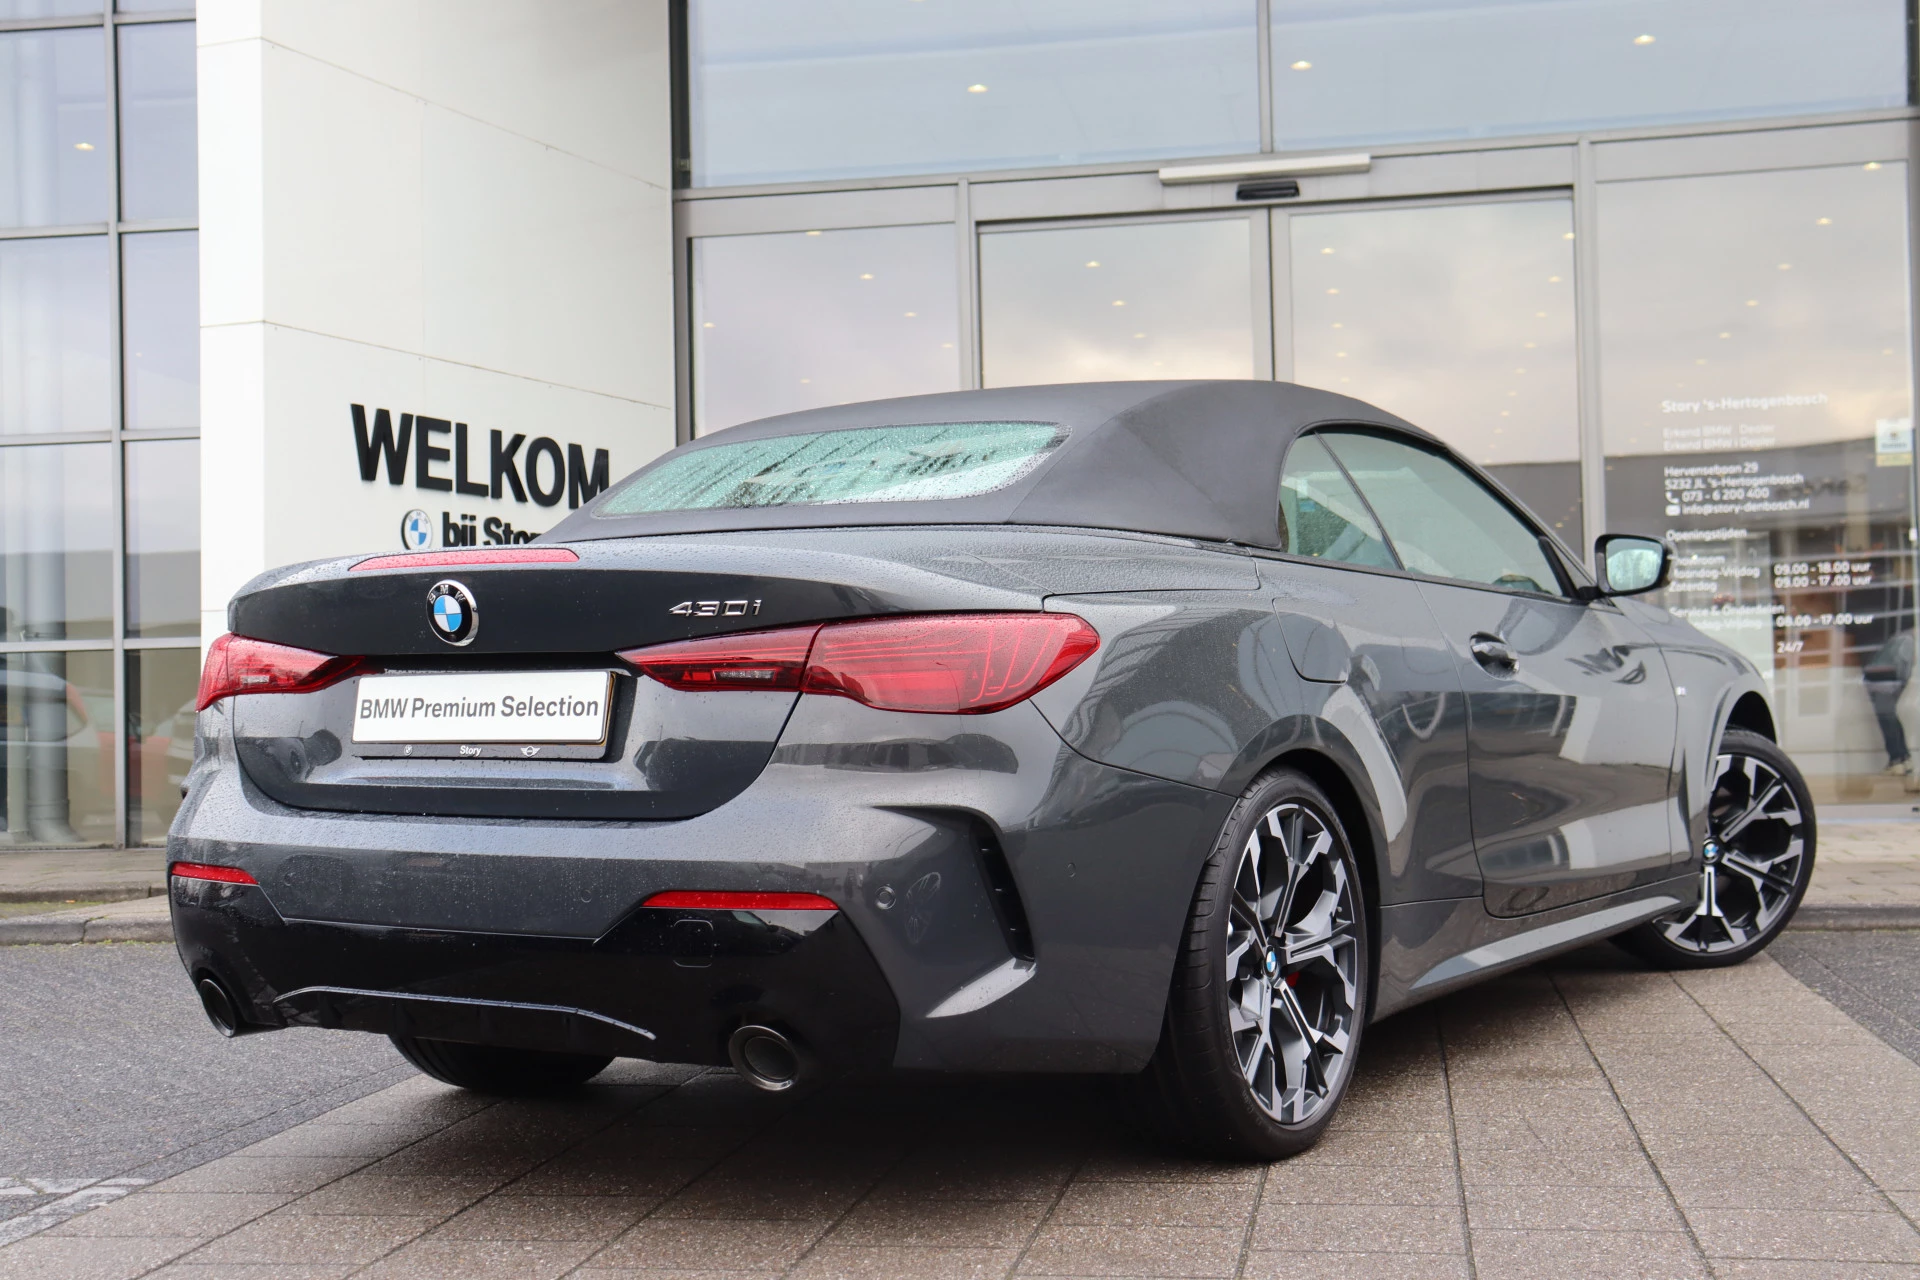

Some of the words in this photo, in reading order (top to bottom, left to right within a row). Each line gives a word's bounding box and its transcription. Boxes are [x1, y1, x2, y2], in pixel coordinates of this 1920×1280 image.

[1662, 399, 1700, 413] Story
[350, 403, 610, 510] WELKOM
[1743, 461, 1759, 474] 29
[1682, 490, 1703, 502] 073
[1712, 489, 1721, 500] 6
[1722, 488, 1745, 500] 200
[1746, 487, 1770, 499] 400
[428, 584, 466, 605] BMW
[668, 599, 762, 617] 430i
[1777, 641, 1804, 653] 24/7
[359, 697, 408, 720] BMW
[411, 696, 496, 719] Premium
[500, 694, 599, 718] Selection
[459, 745, 482, 757] Story
